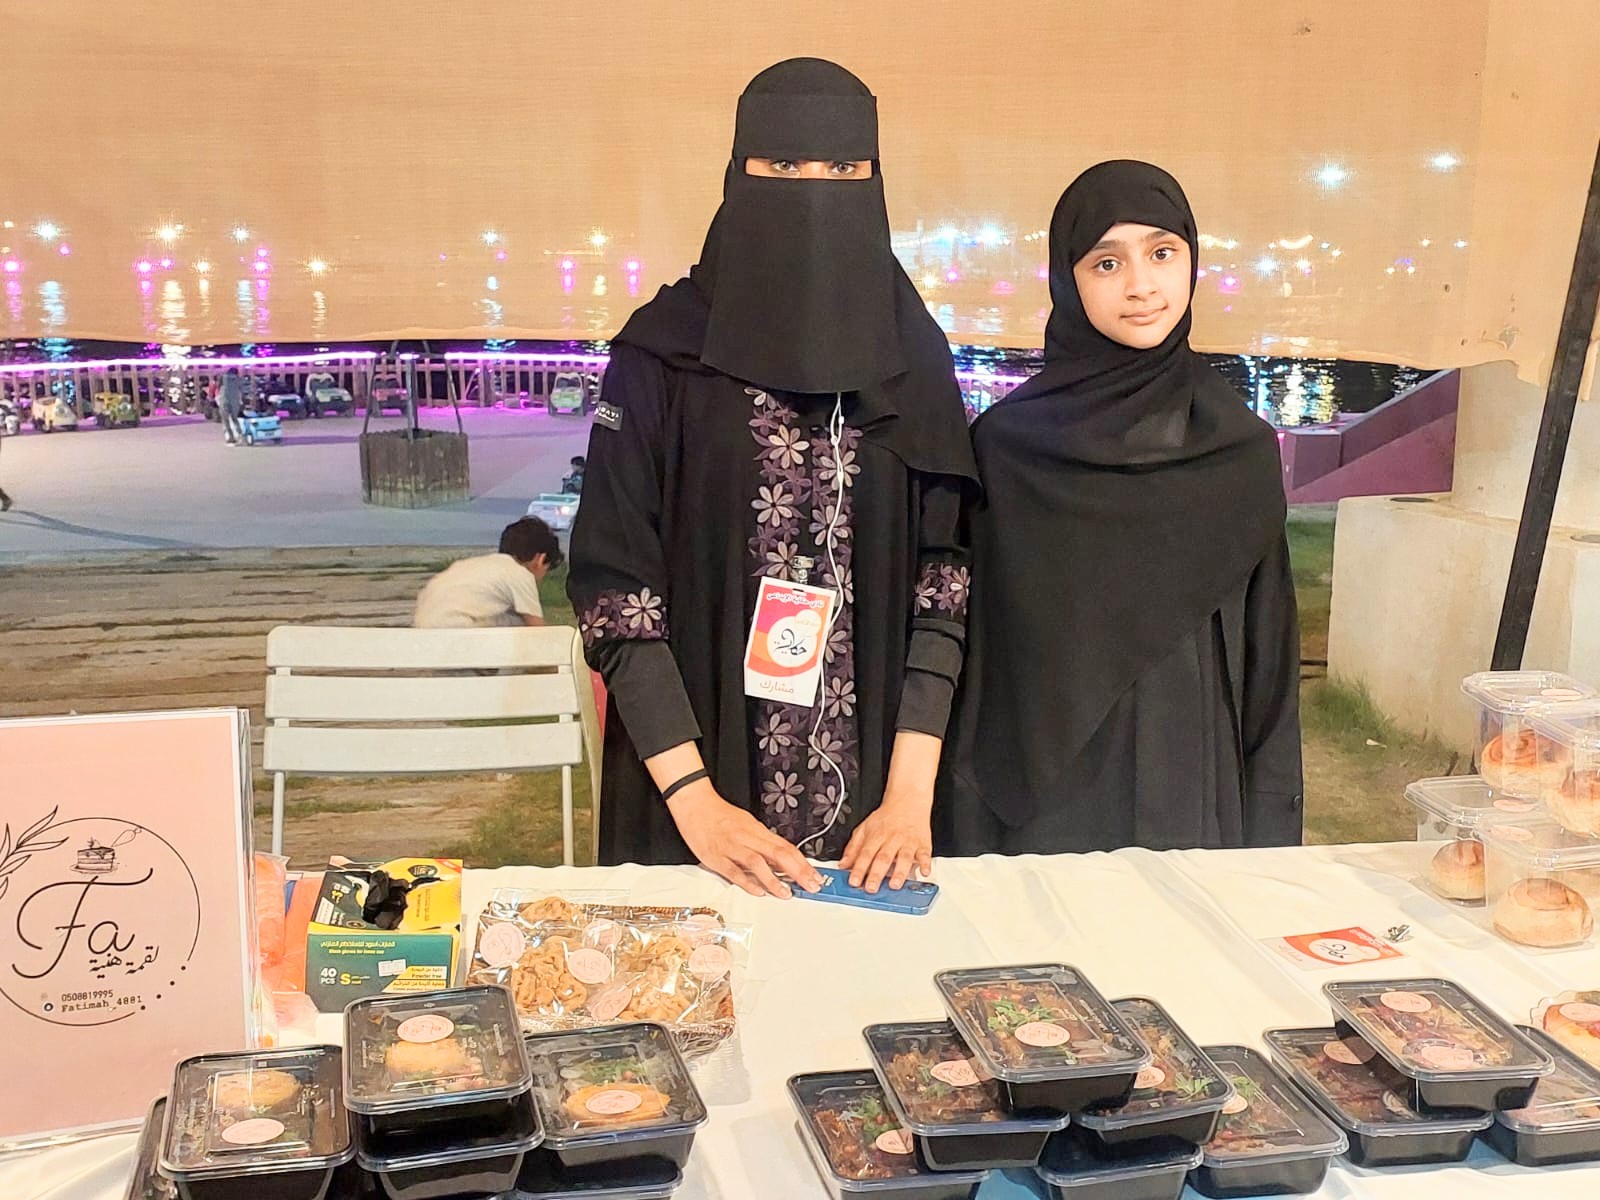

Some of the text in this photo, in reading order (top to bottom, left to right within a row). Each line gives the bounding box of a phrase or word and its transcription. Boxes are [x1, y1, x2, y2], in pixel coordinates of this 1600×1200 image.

[760, 679, 795, 695] مشارك
[89, 945, 160, 979] لقمة هنية
[320, 967, 337, 978] 40
[320, 977, 336, 985] PCS
[339, 973, 351, 985] S
[61, 989, 114, 1002] 0508819995
